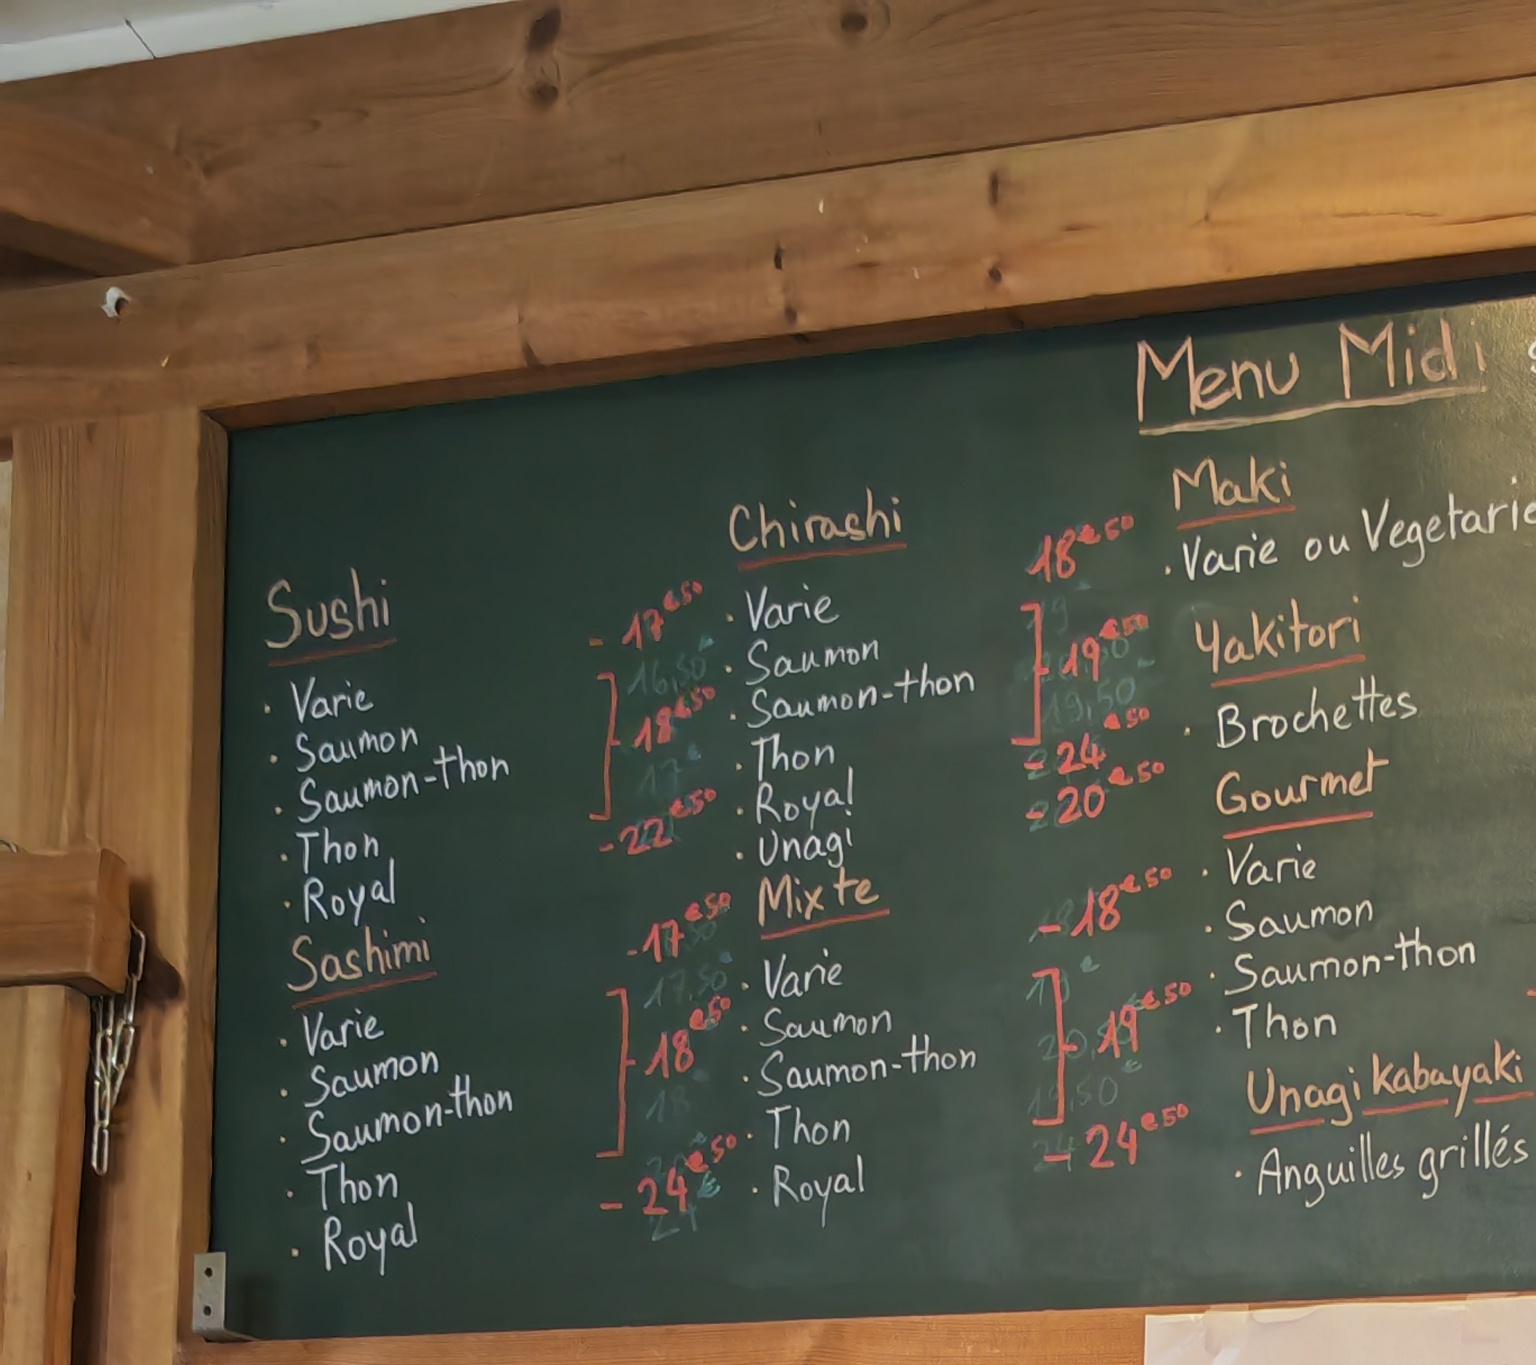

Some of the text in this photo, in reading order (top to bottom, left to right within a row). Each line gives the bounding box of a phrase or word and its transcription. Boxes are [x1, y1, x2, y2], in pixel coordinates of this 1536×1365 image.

[1136, 335, 1300, 423] Menu
[1339, 318, 1486, 400] Midi
[1171, 456, 1292, 512] Maki
[729, 487, 902, 553] Chirashi
[1304, 532, 1350, 565] ou
[264, 567, 391, 649] Sushi
[745, 583, 840, 633] Varie
[1195, 594, 1361, 674] Yakitori
[747, 638, 879, 685] Saumon
[290, 676, 373, 723] Varie
[1216, 675, 1418, 749] Brochettes
[296, 726, 418, 773] Saumon
[750, 732, 835, 782] Thon
[755, 766, 853, 828] Royal
[1215, 748, 1389, 816] Gourmet
[295, 827, 379, 874] Thon
[758, 811, 853, 870] Unagi
[1226, 842, 1317, 887] Varie
[303, 858, 396, 926] Royal
[758, 866, 880, 926] Mixte
[1225, 899, 1373, 942] Saumon
[287, 916, 431, 991] Sashimi
[763, 948, 843, 998] Varie
[302, 1008, 384, 1056] Varie
[760, 1007, 892, 1047] Saumon
[1232, 1003, 1337, 1049] Thon
[305, 1050, 438, 1107] Saumon
[1247, 1065, 1361, 1127] Unagi
[765, 1107, 851, 1150] Thon
[306, 1162, 398, 1211] Thon
[773, 1155, 865, 1228] Royal
[1257, 1131, 1406, 1209] Anguilles
[323, 1201, 418, 1276] Royal
